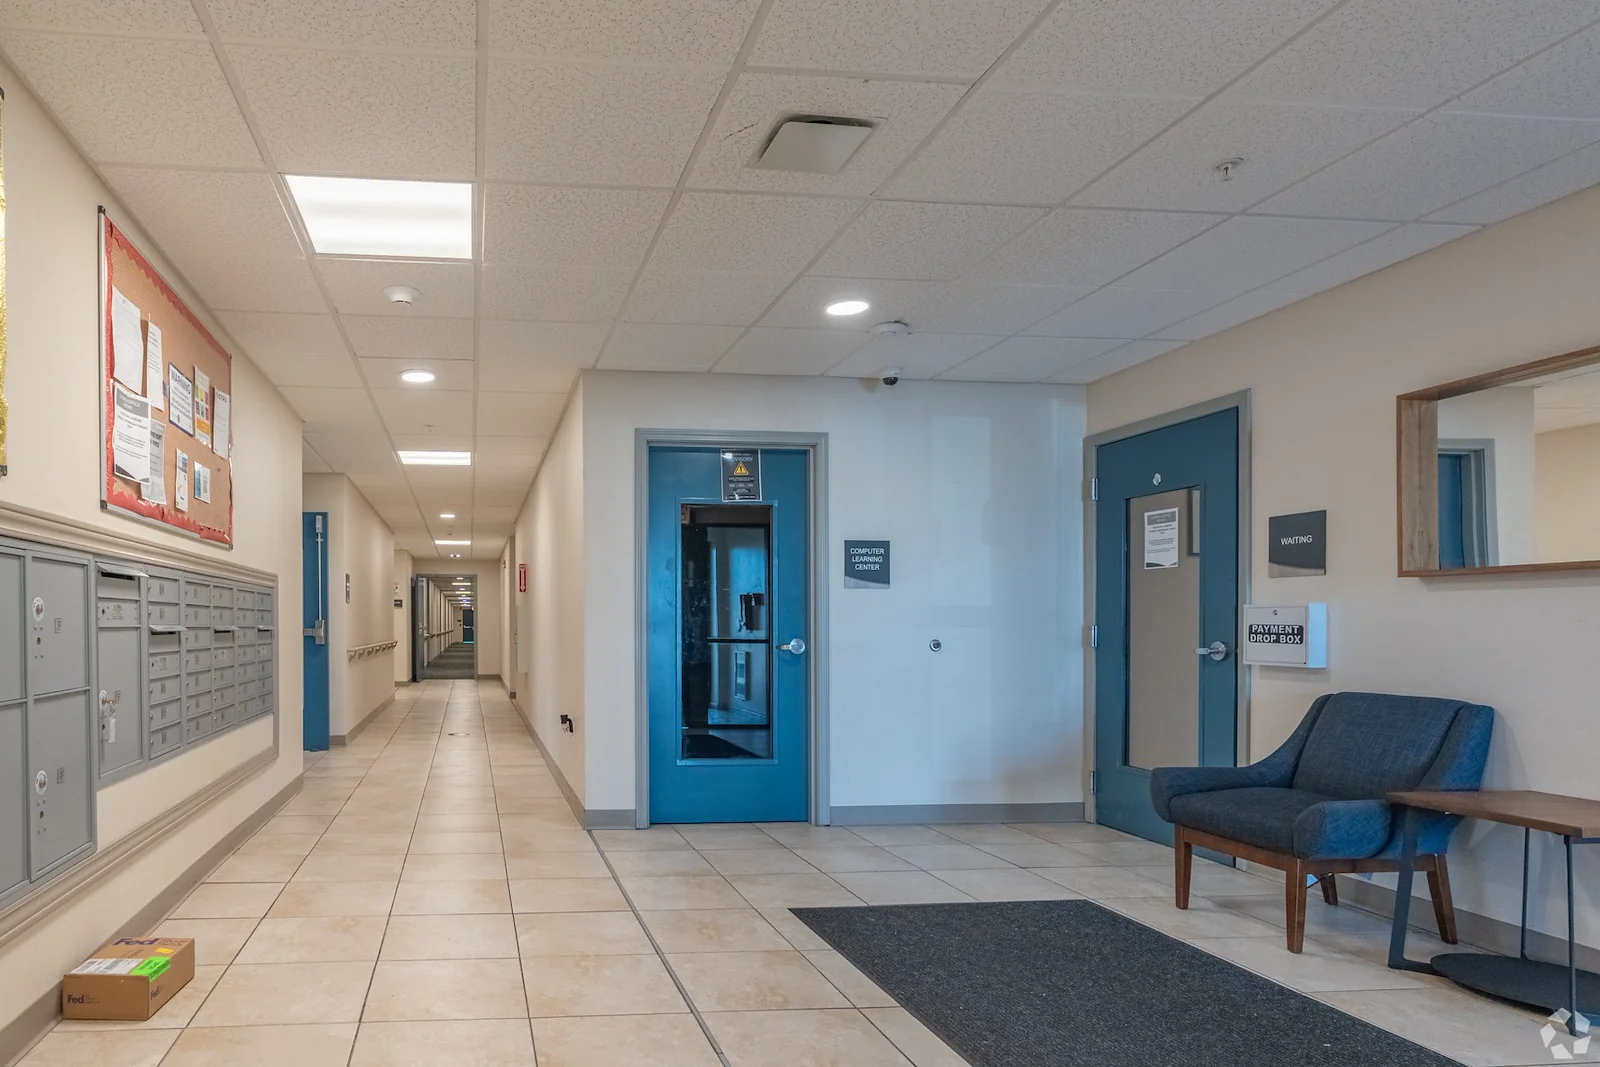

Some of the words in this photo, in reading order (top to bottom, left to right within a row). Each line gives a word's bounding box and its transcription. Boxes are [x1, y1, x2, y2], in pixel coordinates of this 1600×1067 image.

[1280, 535, 1313, 545] WAITING
[850, 547, 885, 555] COMPUTER
[854, 563, 880, 571] CENTER
[1252, 625, 1300, 635] PAYMENT
[1250, 633, 1277, 643] DROP
[1279, 634, 1301, 644] BOX
